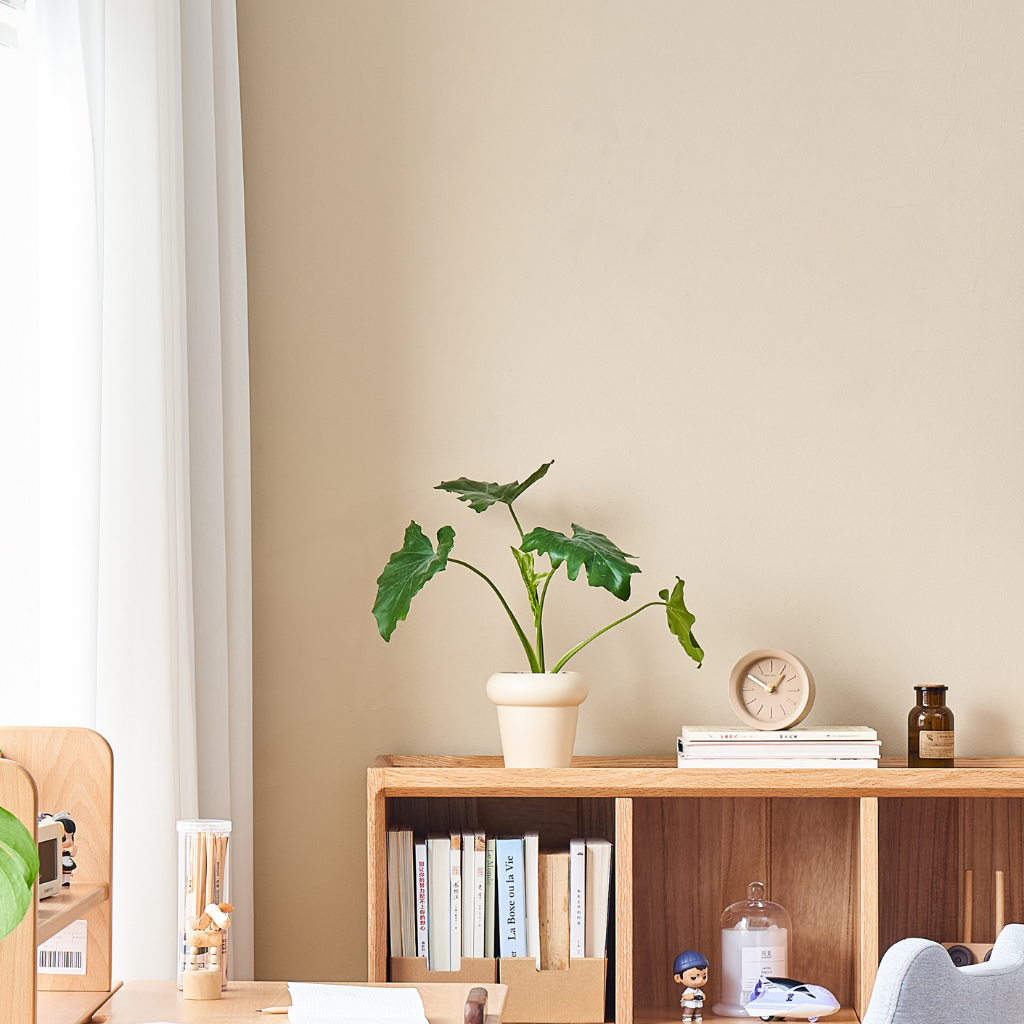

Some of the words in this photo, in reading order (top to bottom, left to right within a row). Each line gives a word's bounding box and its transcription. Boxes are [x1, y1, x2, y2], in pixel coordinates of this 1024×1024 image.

[505, 855, 514, 872] Vie
[506, 874, 515, 883] la
[418, 861, 426, 932] 别让你的努力配不上你的野心
[507, 888, 516, 898] ou
[507, 900, 516, 925] Boxe
[508, 925, 517, 941] La
